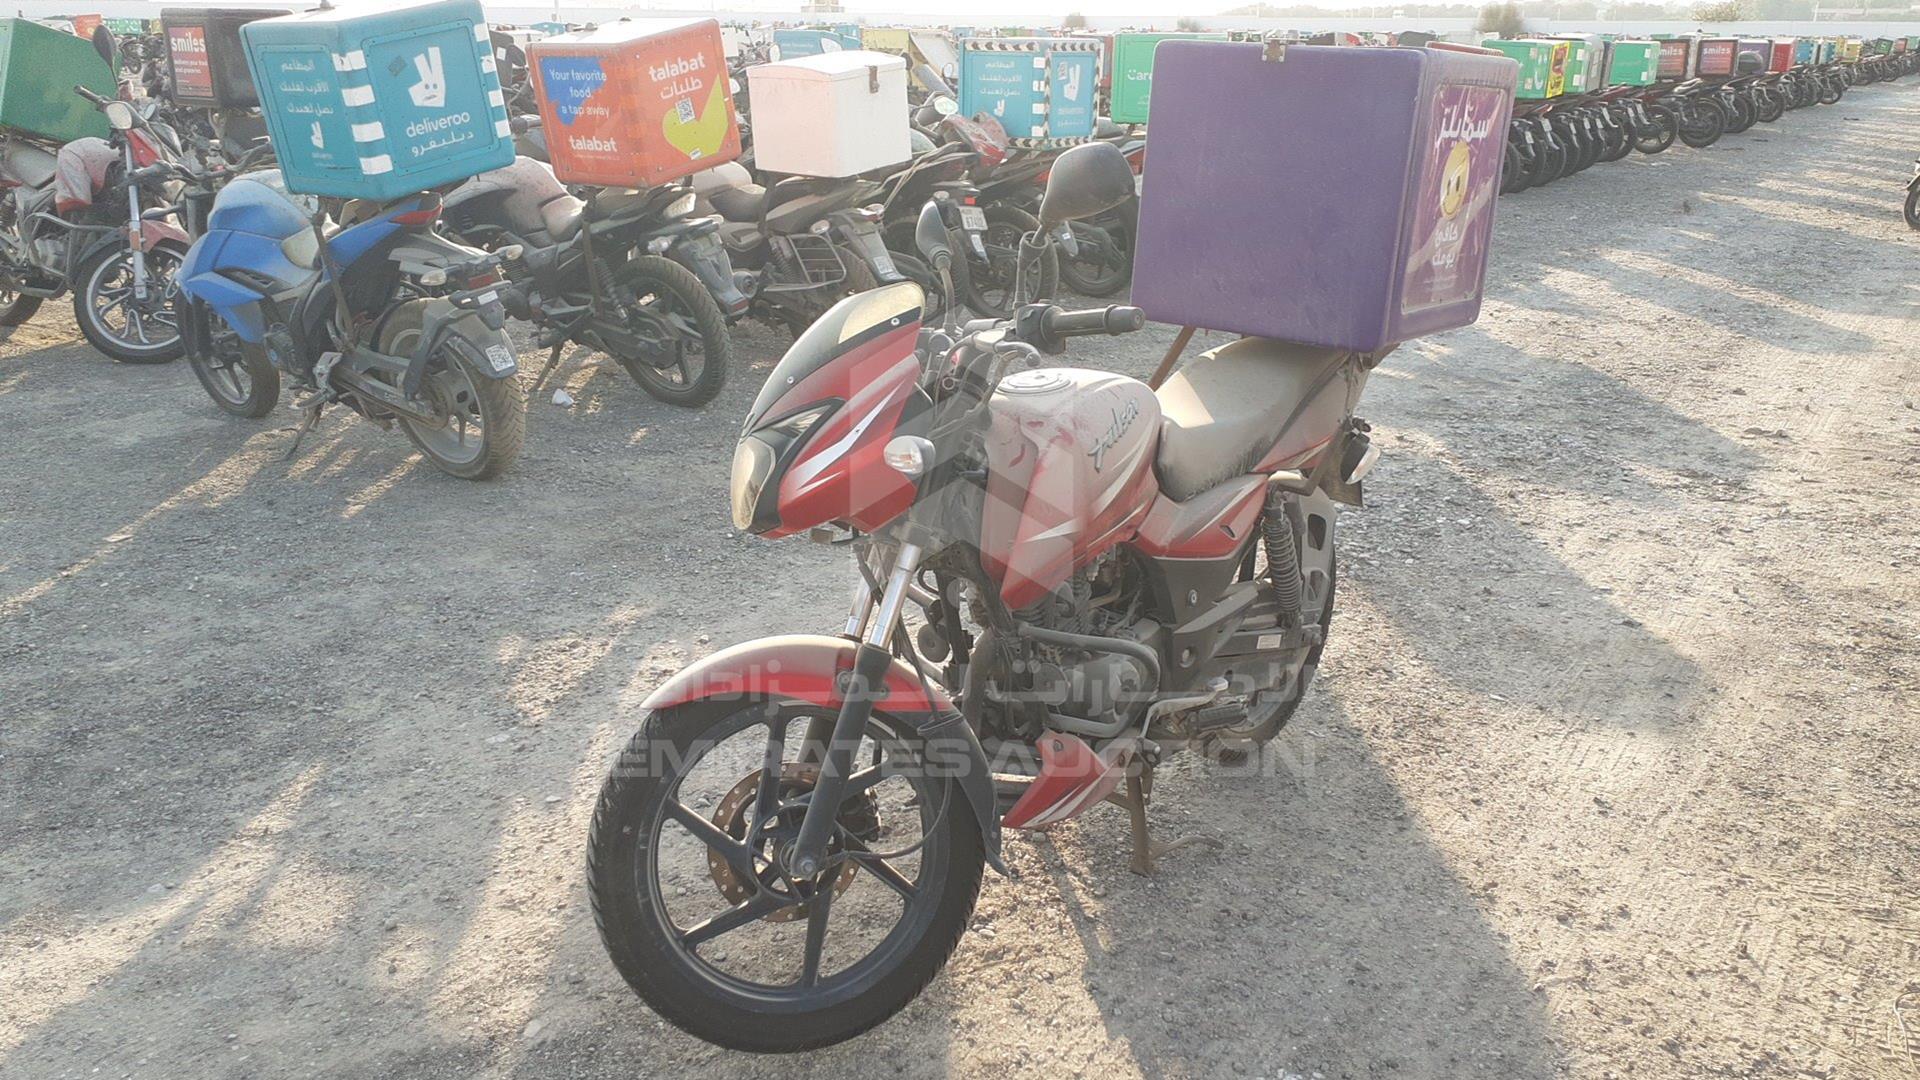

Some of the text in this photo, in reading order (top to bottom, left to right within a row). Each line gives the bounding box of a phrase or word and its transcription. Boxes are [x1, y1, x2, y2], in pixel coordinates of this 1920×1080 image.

[171, 31, 206, 53] smiles
[1703, 45, 1731, 56] smiles
[549, 69, 607, 81] Your favorite
[648, 52, 706, 82] talabat
[660, 76, 703, 99] طلبات
[561, 105, 609, 118] a tap away
[406, 112, 471, 138] deliveroo
[411, 131, 474, 157] ديليفرو
[568, 135, 618, 152] talabat
